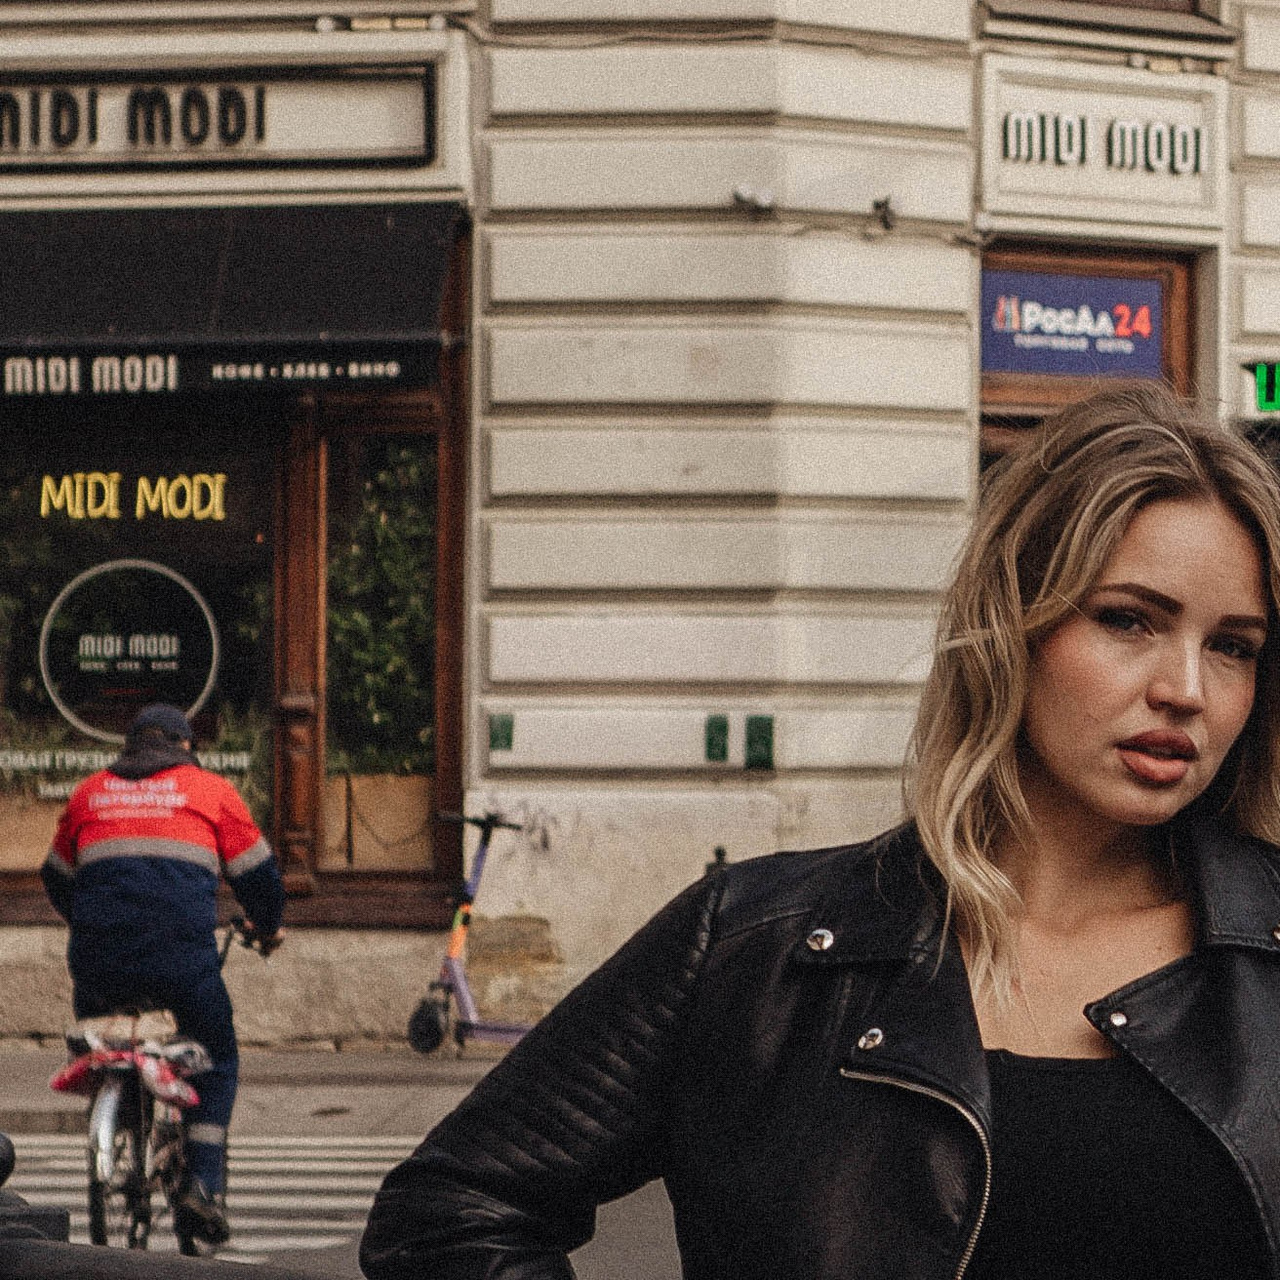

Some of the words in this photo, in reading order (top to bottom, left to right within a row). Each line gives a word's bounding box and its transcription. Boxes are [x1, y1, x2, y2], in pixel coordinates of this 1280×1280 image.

[127, 85, 266, 146] MODI
[4, 356, 80, 394] MIDI
[92, 354, 178, 392] MODI
[41, 473, 121, 519] MIDI
[136, 473, 226, 520] MODI
[79, 634, 122, 657] MIDI
[128, 634, 179, 658] MODI
